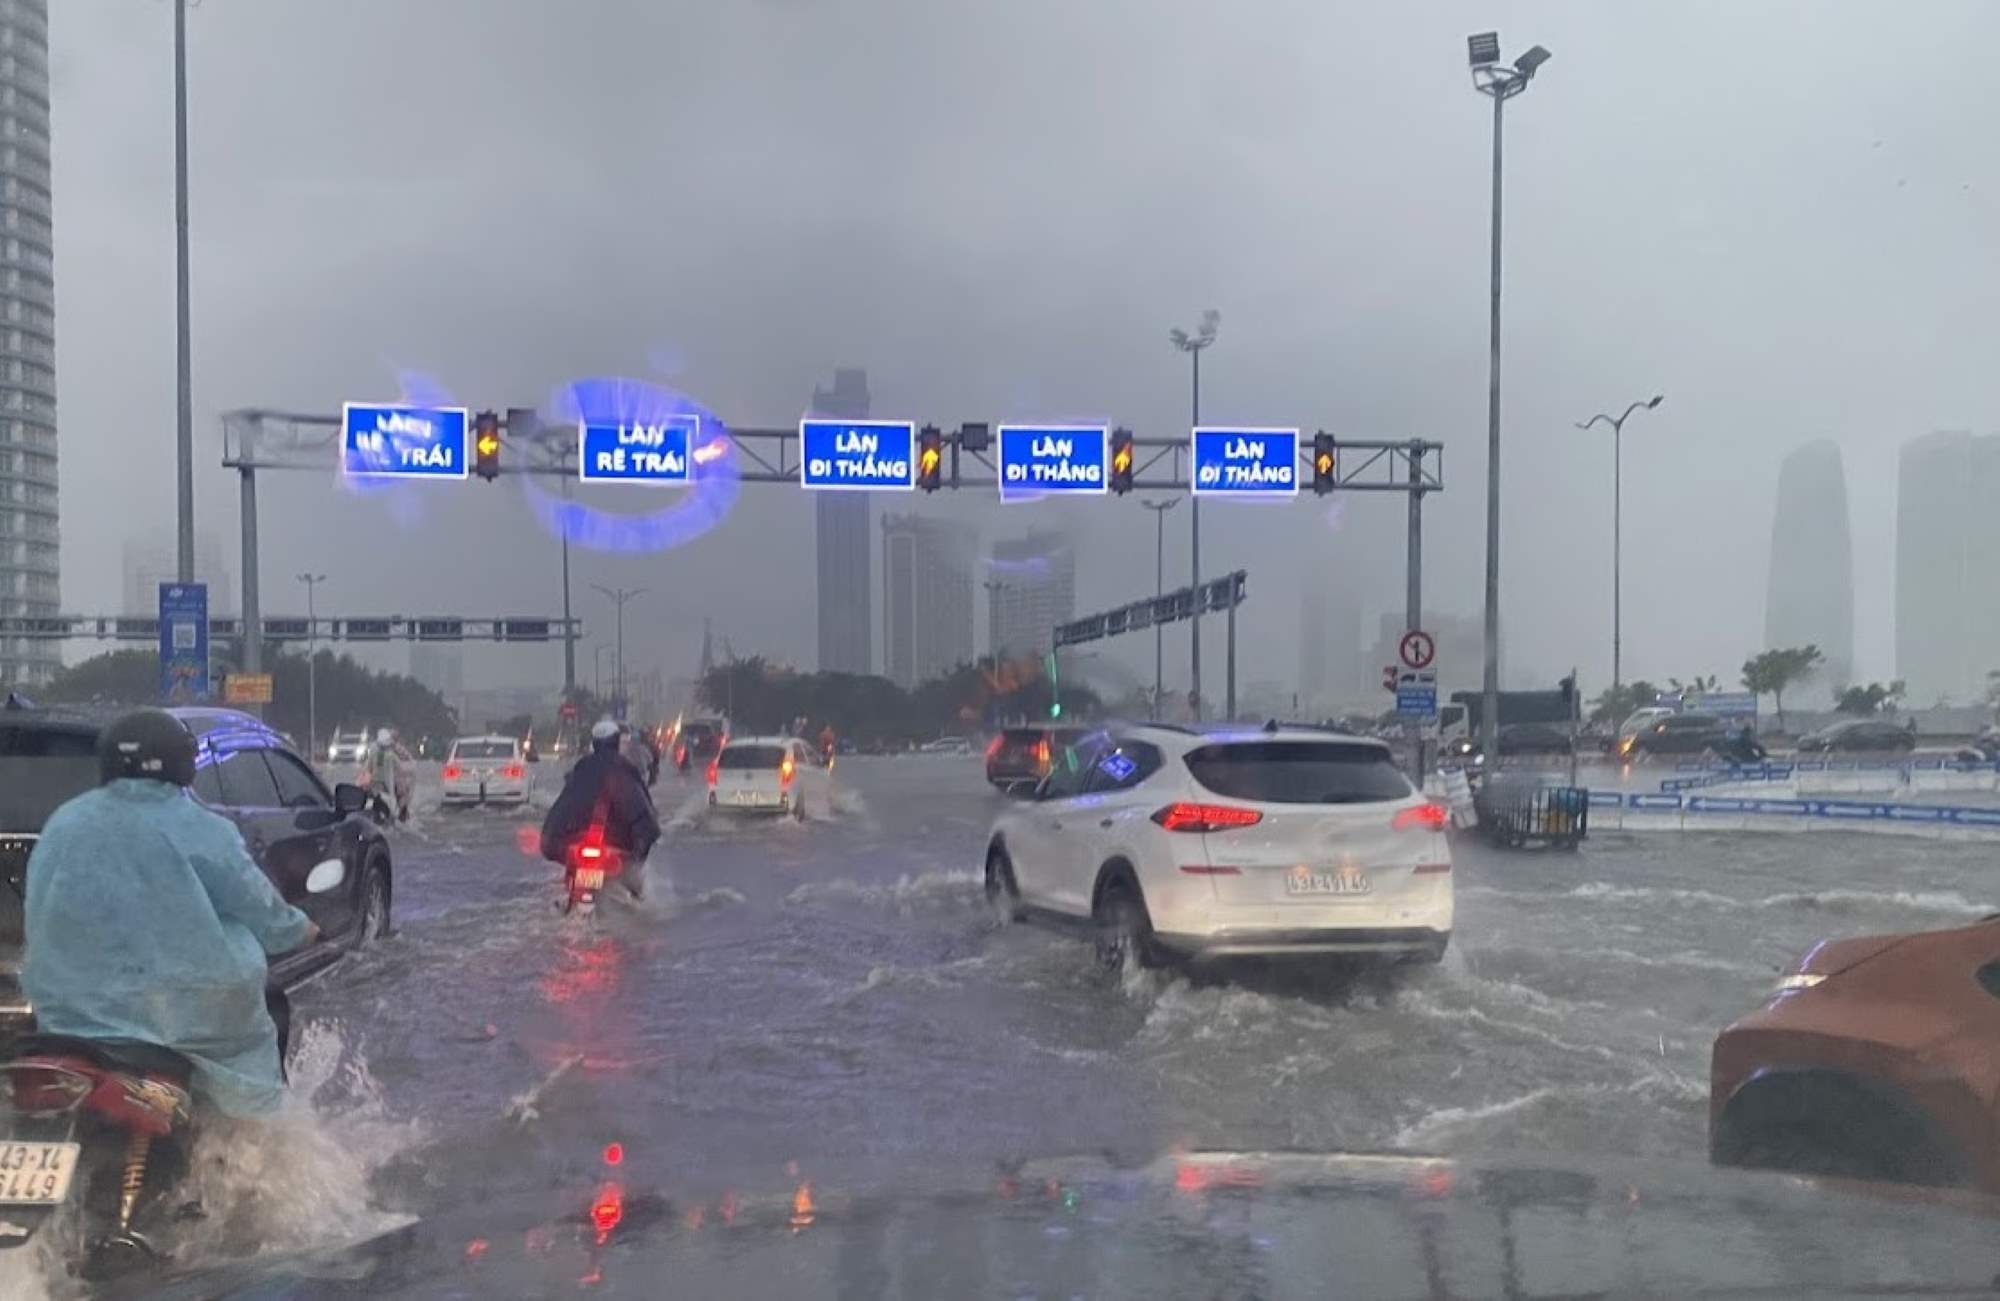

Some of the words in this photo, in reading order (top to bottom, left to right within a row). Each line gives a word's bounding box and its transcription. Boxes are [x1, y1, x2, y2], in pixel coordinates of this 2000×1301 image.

[836, 430, 878, 453] LÀN
[1032, 435, 1073, 457] LÀN
[1224, 437, 1265, 459] LÀN
[631, 450, 685, 472] TRÁI
